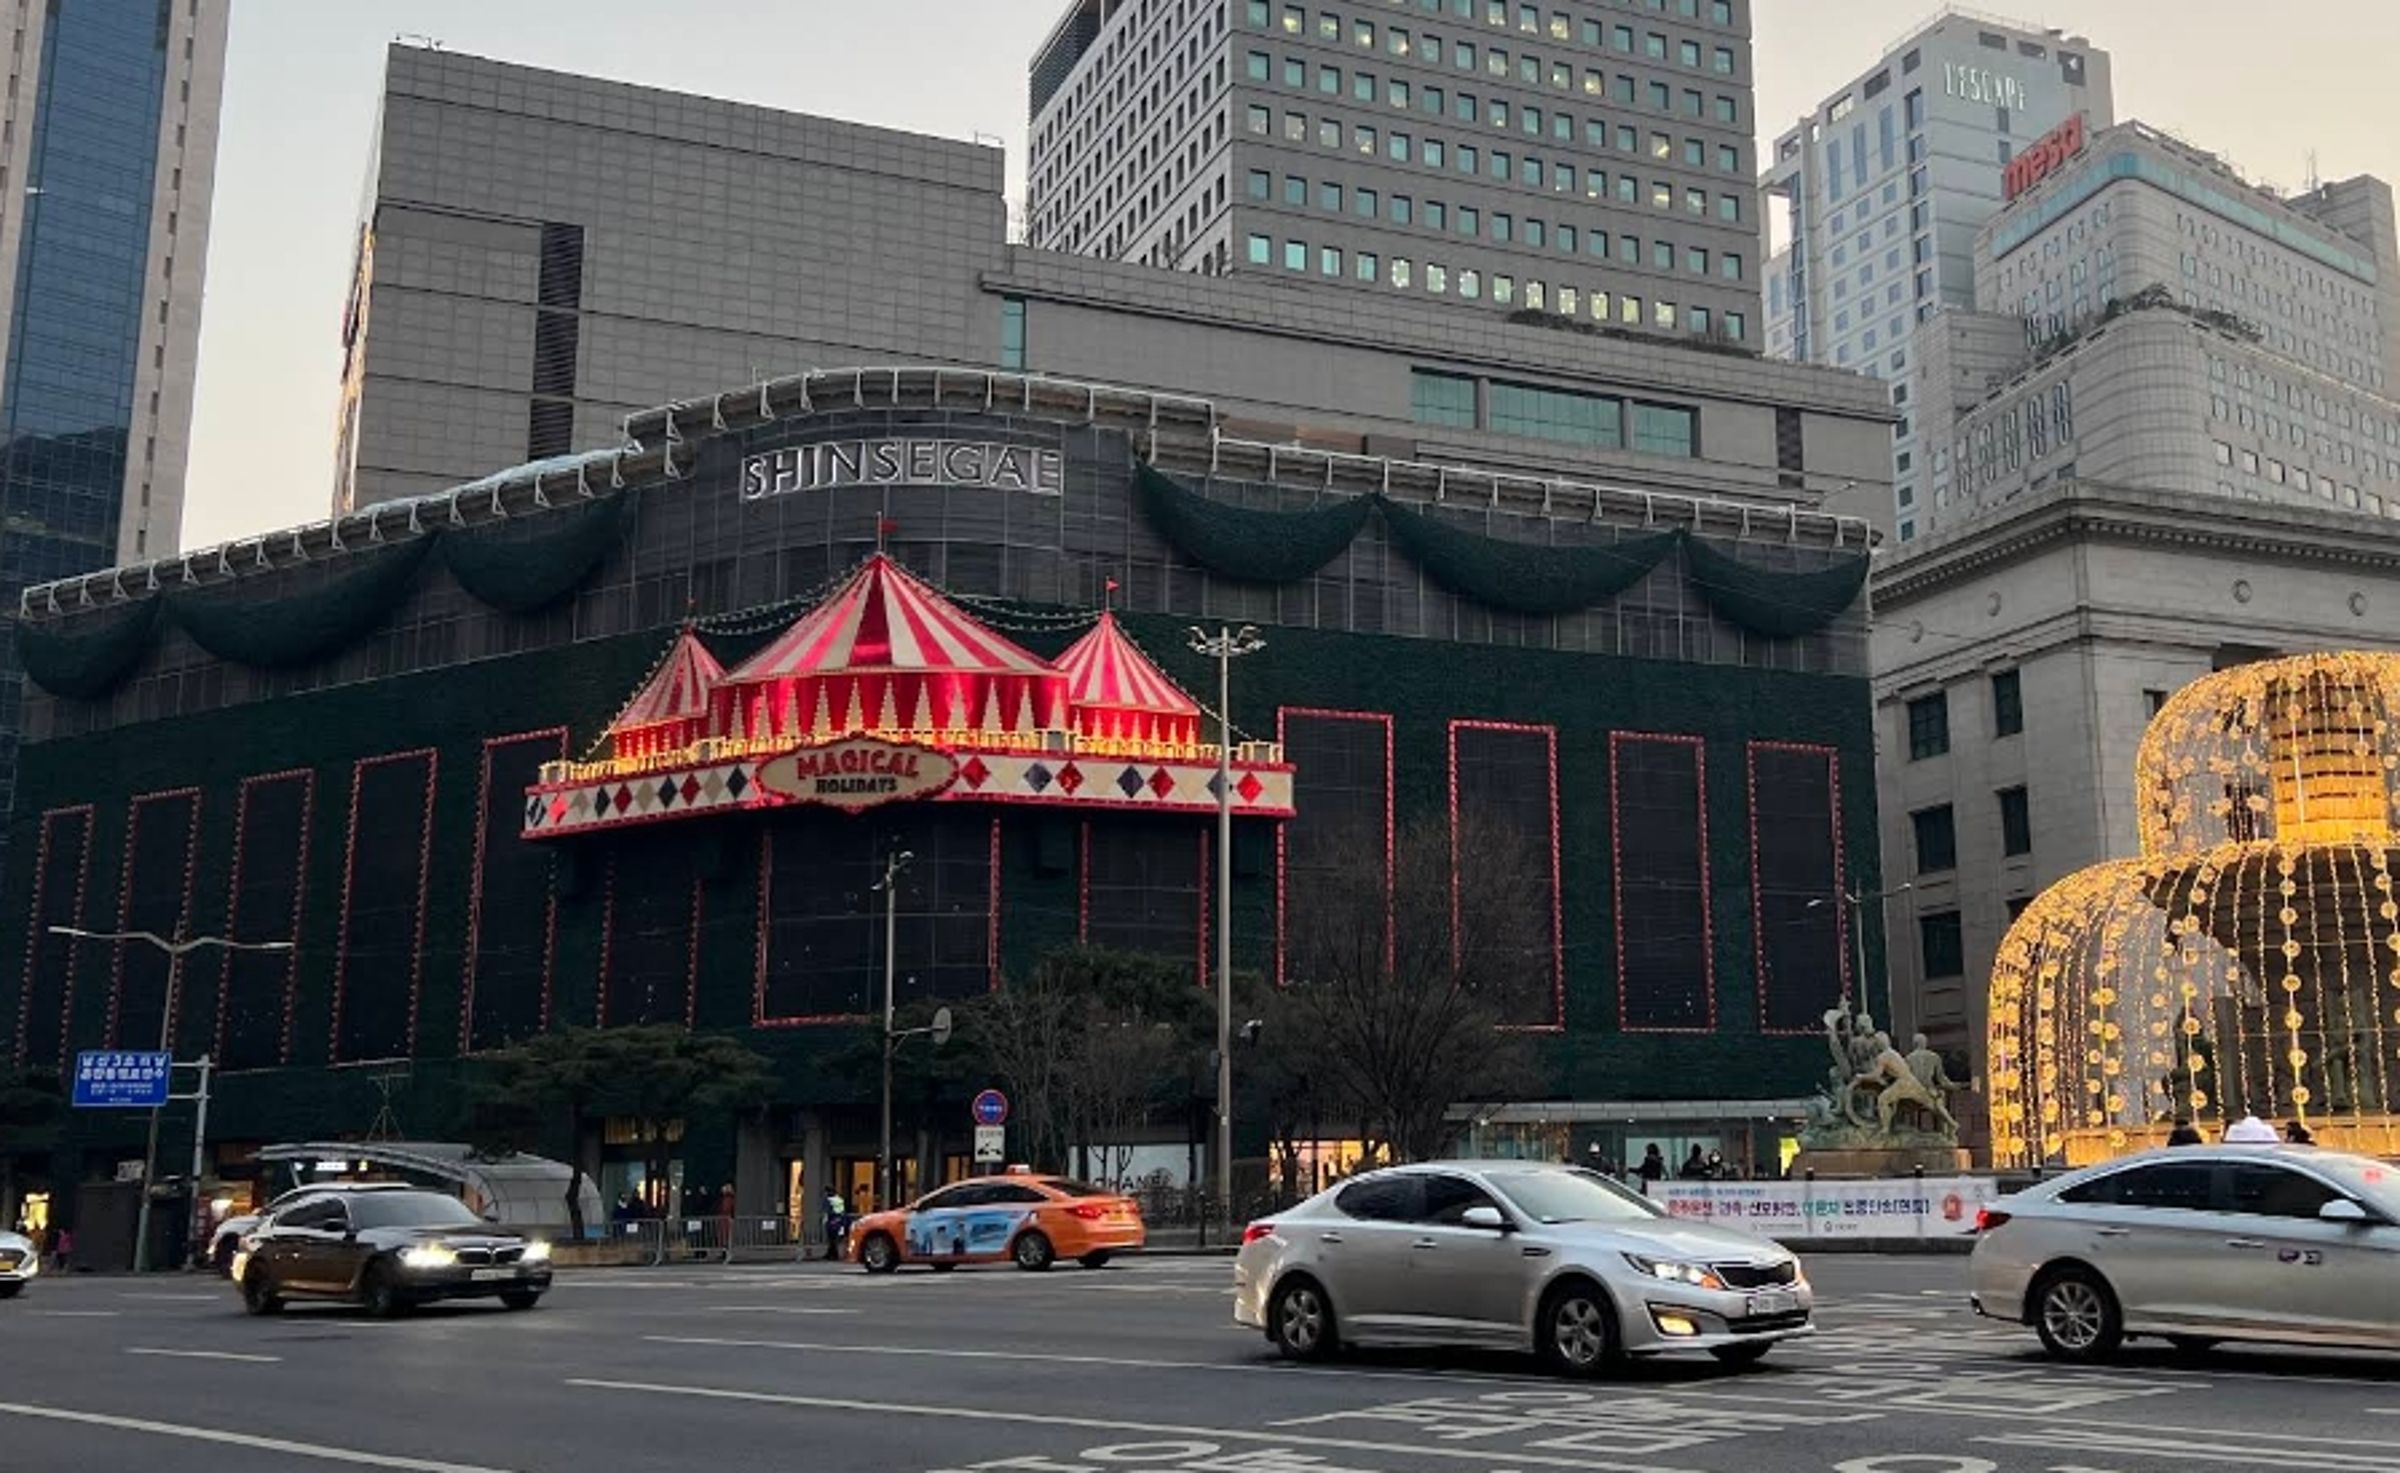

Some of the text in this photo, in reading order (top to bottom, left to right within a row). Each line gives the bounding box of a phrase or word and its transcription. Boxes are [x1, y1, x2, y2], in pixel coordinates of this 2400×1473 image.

[1944, 62, 2025, 110] L'ESCAPE
[2004, 112, 2082, 201] mesa
[740, 440, 1063, 501] SHINSEGAE
[796, 750, 919, 780] MAGICAL
[815, 777, 897, 794] HOLIDAYS
